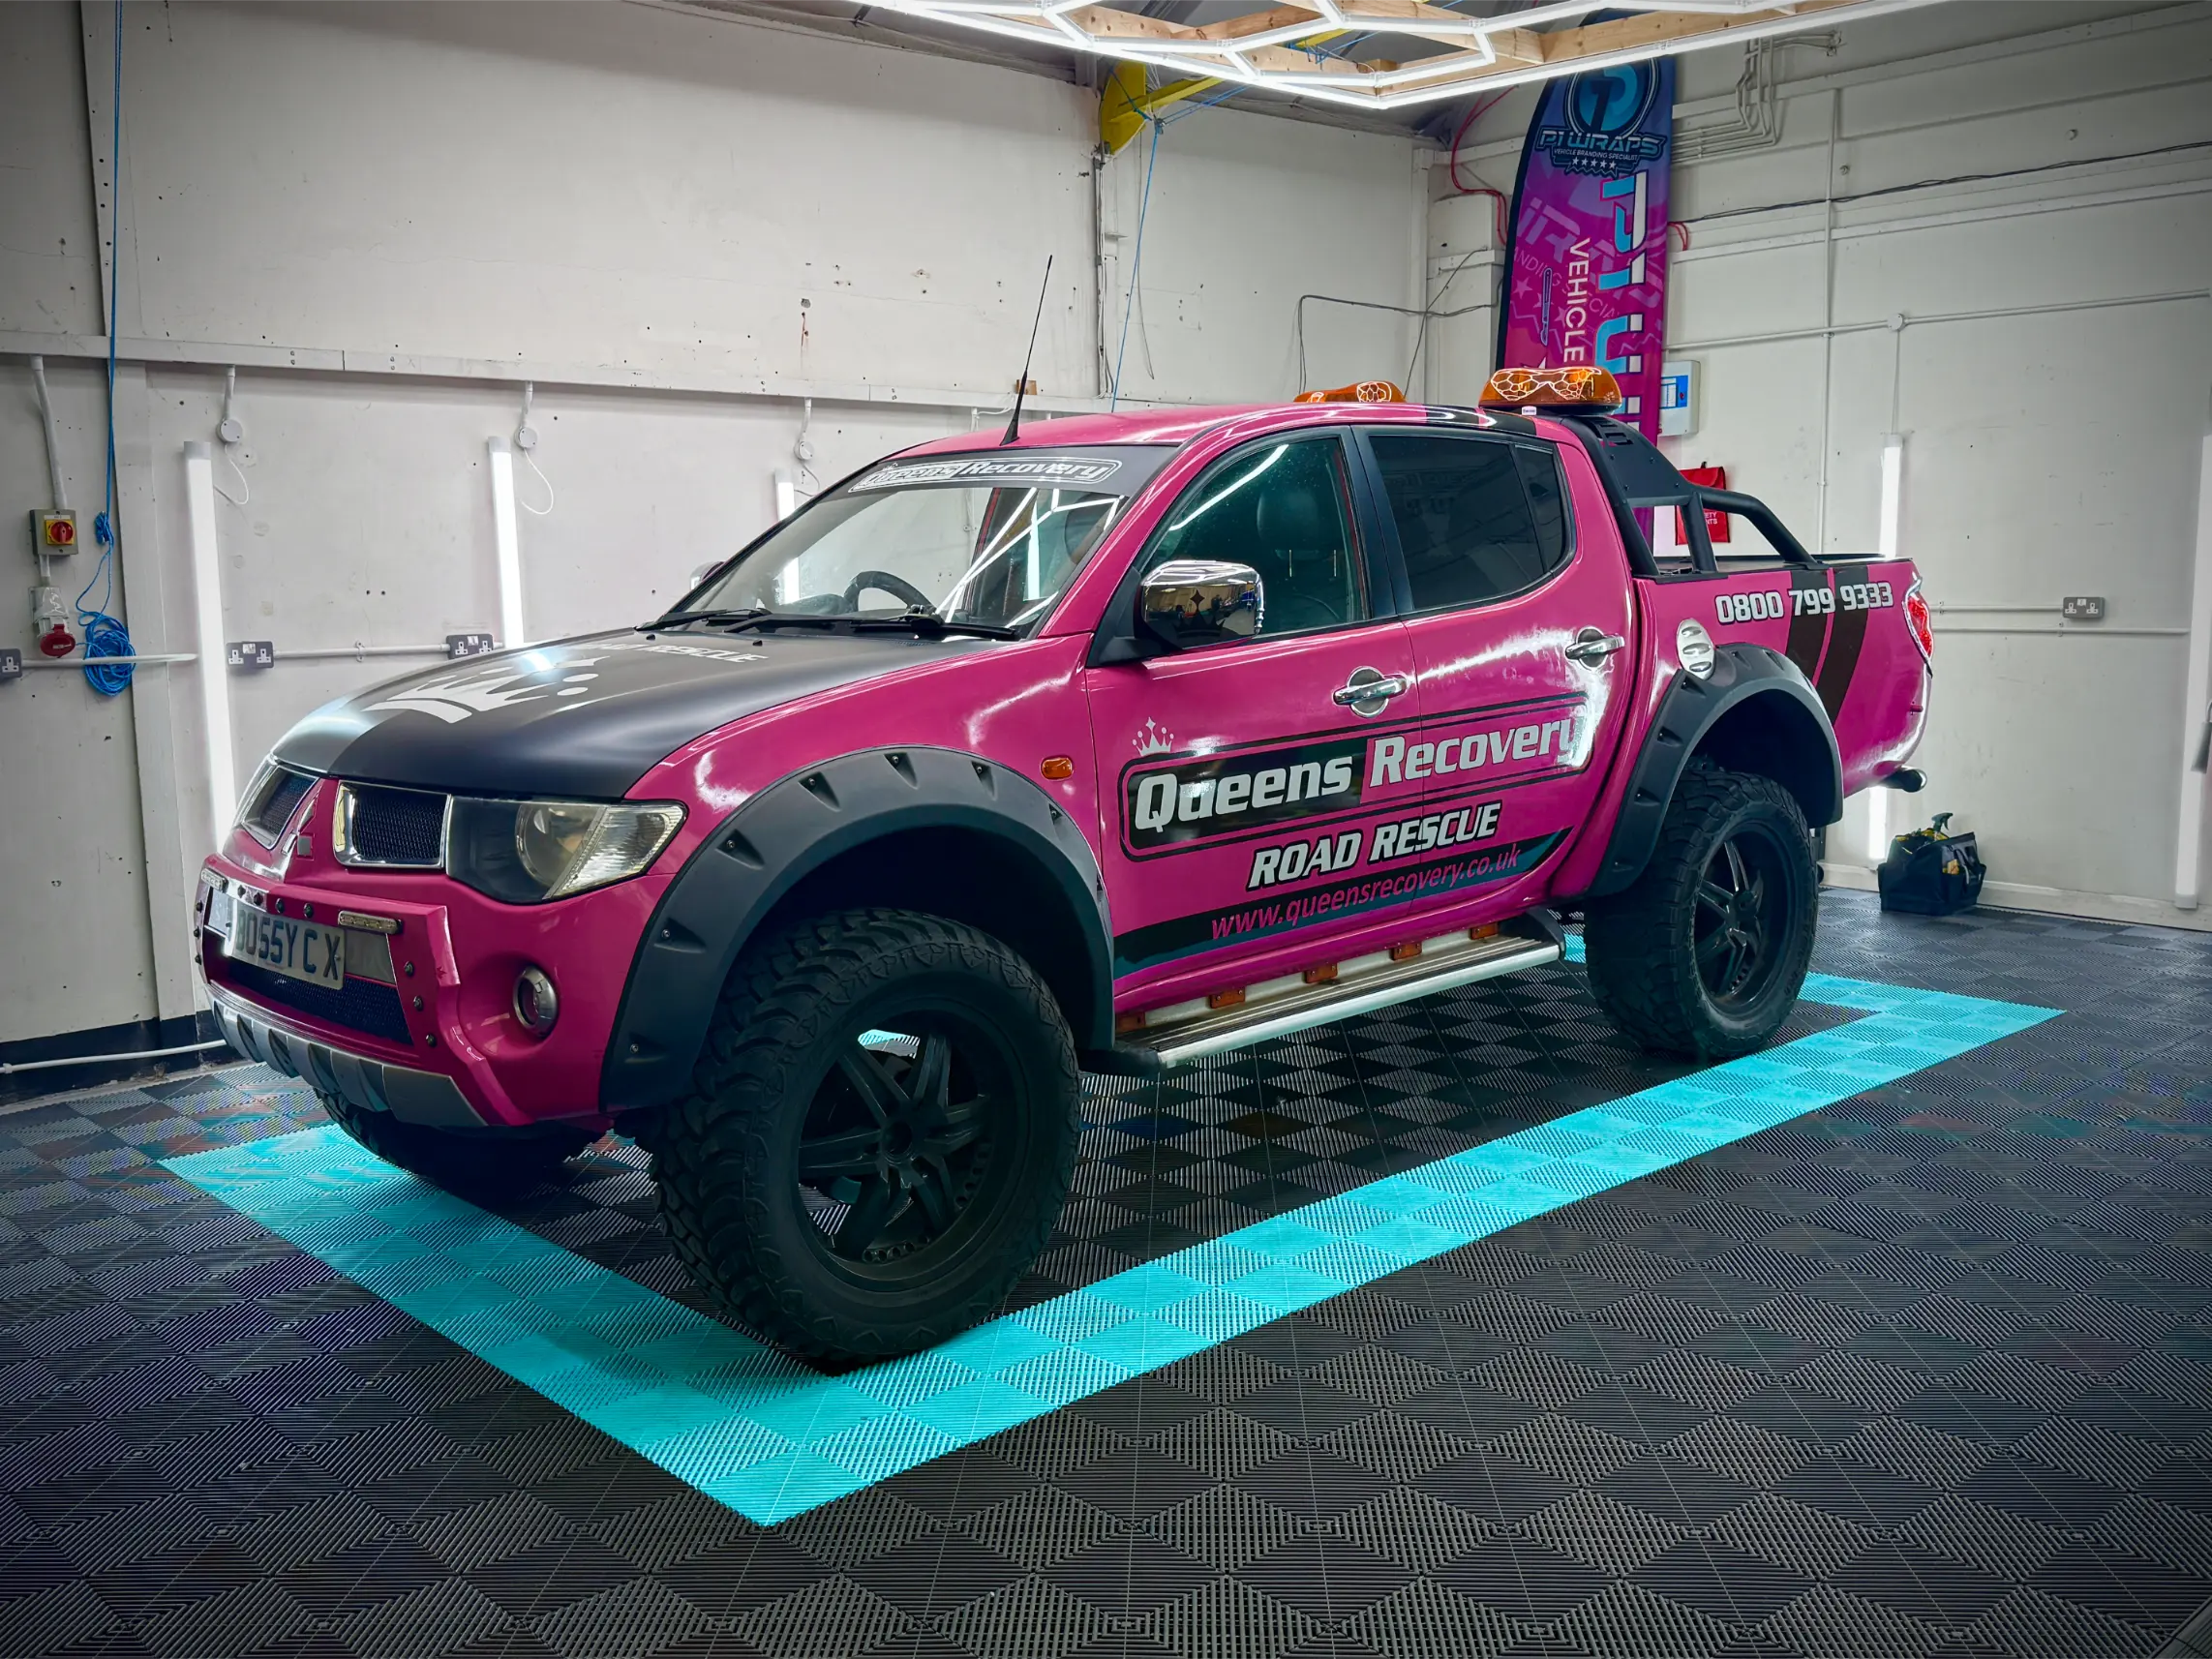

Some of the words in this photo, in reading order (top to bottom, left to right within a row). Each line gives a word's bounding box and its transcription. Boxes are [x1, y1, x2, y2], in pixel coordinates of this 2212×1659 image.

[1567, 132, 1661, 155] WRAPS
[1576, 149, 1608, 159] BRANDING
[1563, 236, 1591, 363] VEHICLE
[959, 461, 1110, 480] Recovery
[1714, 591, 1784, 624] 0800
[1788, 588, 1836, 616] 799
[1839, 582, 1894, 611] 9333
[1135, 755, 1353, 833] Queens
[1369, 715, 1585, 788] Recovery
[1248, 830, 1363, 889] ROAD
[1369, 802, 1501, 862] RESCUE
[1211, 845, 1520, 940] www.queensrecovery.co.uk
